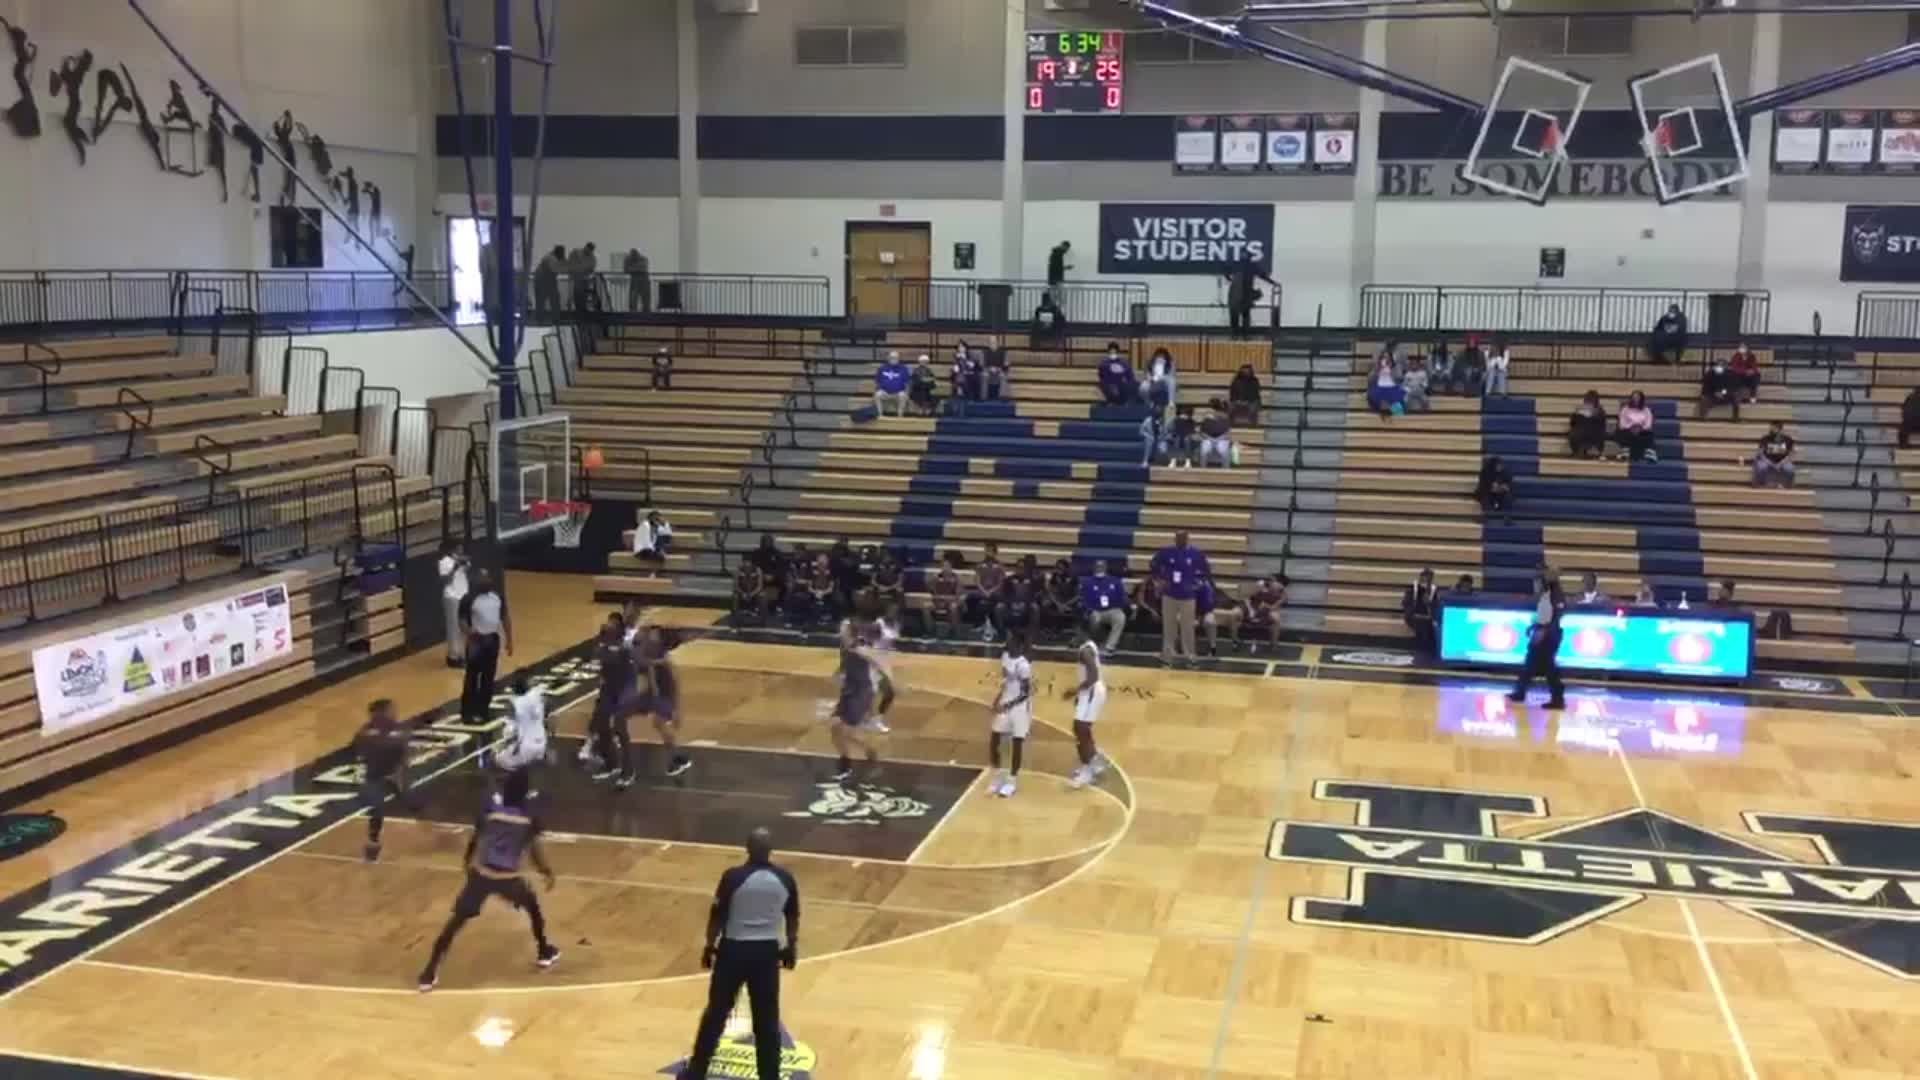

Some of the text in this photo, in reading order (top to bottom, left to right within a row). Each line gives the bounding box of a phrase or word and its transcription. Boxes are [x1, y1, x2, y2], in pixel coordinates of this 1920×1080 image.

[1038, 61, 1055, 80] 19
[1096, 60, 1120, 80] 25
[1030, 87, 1043, 107] 0
[1107, 87, 1120, 107] 0
[1378, 162, 1738, 197] BE SOMEBODY
[1132, 217, 1247, 239] VISITOR
[1113, 239, 1265, 262] STUDENTS
[1886, 235, 1920, 254] ST
[0, 792, 359, 976] ARIETTA
